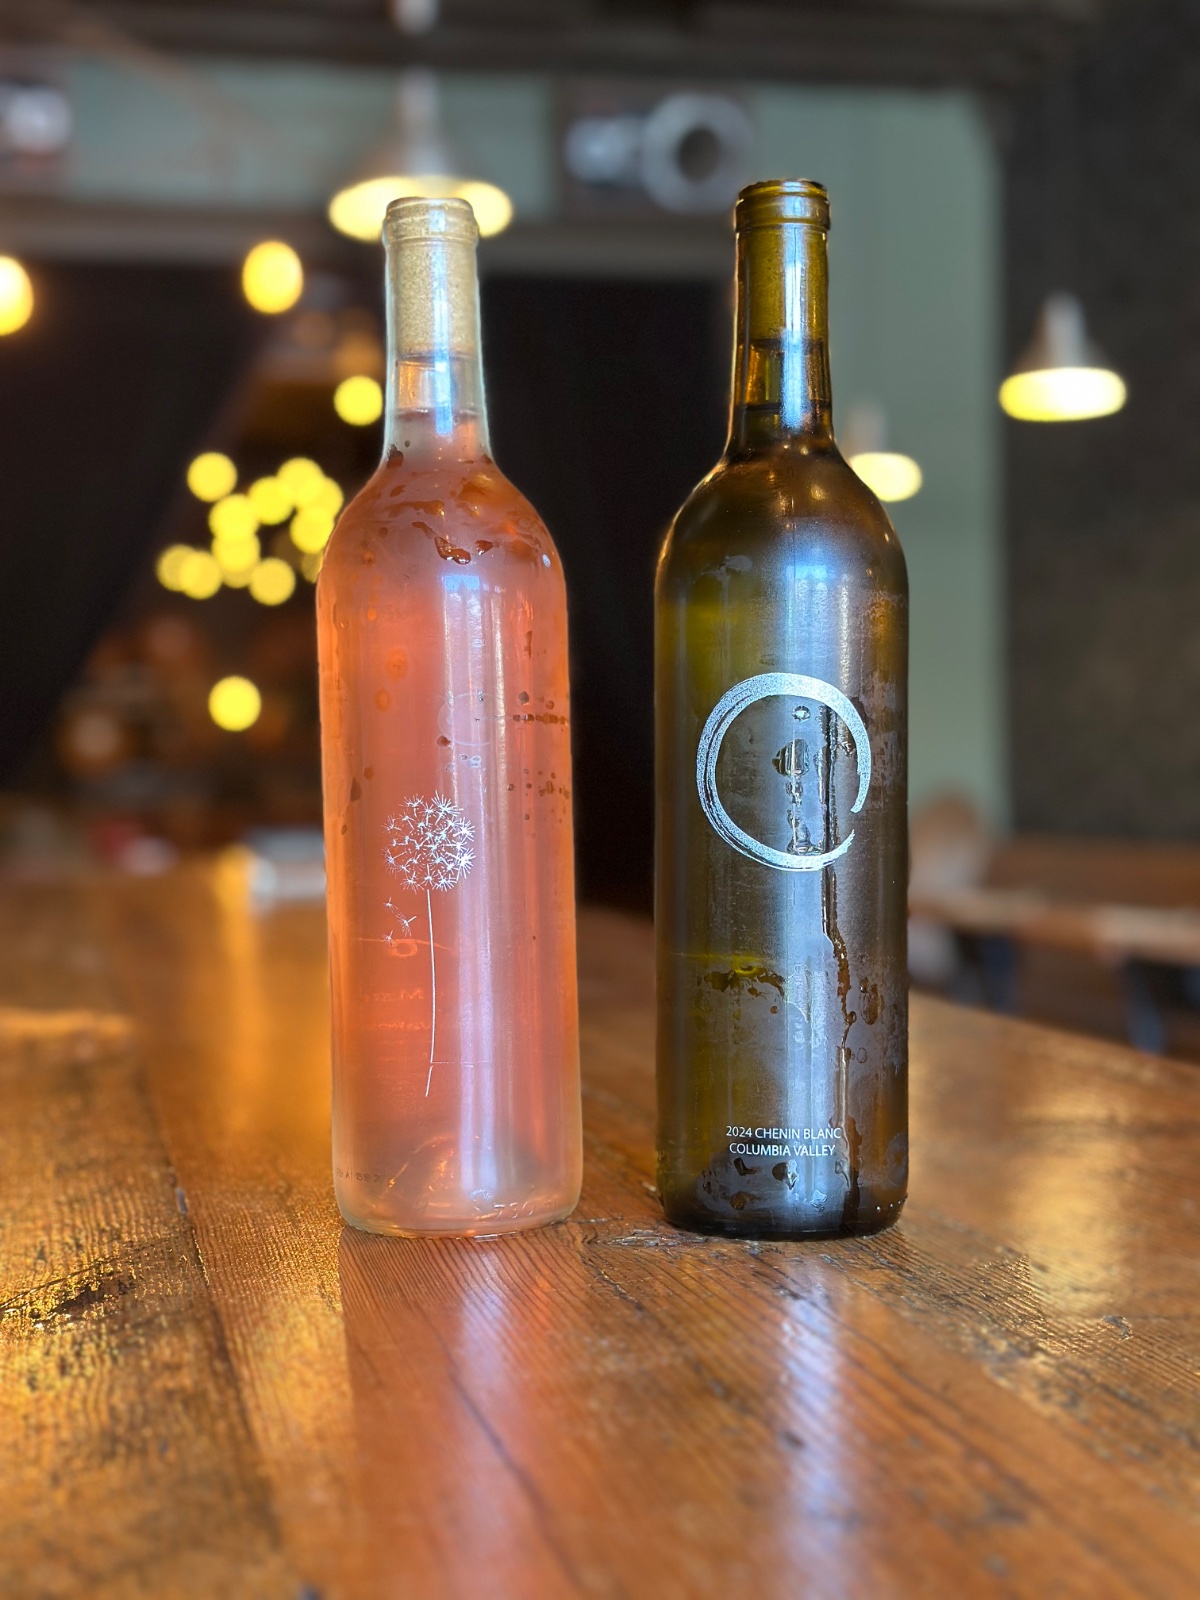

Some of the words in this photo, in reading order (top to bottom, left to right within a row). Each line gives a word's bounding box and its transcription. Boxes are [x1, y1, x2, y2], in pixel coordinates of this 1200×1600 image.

[726, 1125, 752, 1138] 2024
[754, 1127, 801, 1140] CHENIN
[803, 1128, 842, 1140] BLANC
[729, 1142, 791, 1157] COLUMBIA
[793, 1144, 836, 1157] VALLEY
